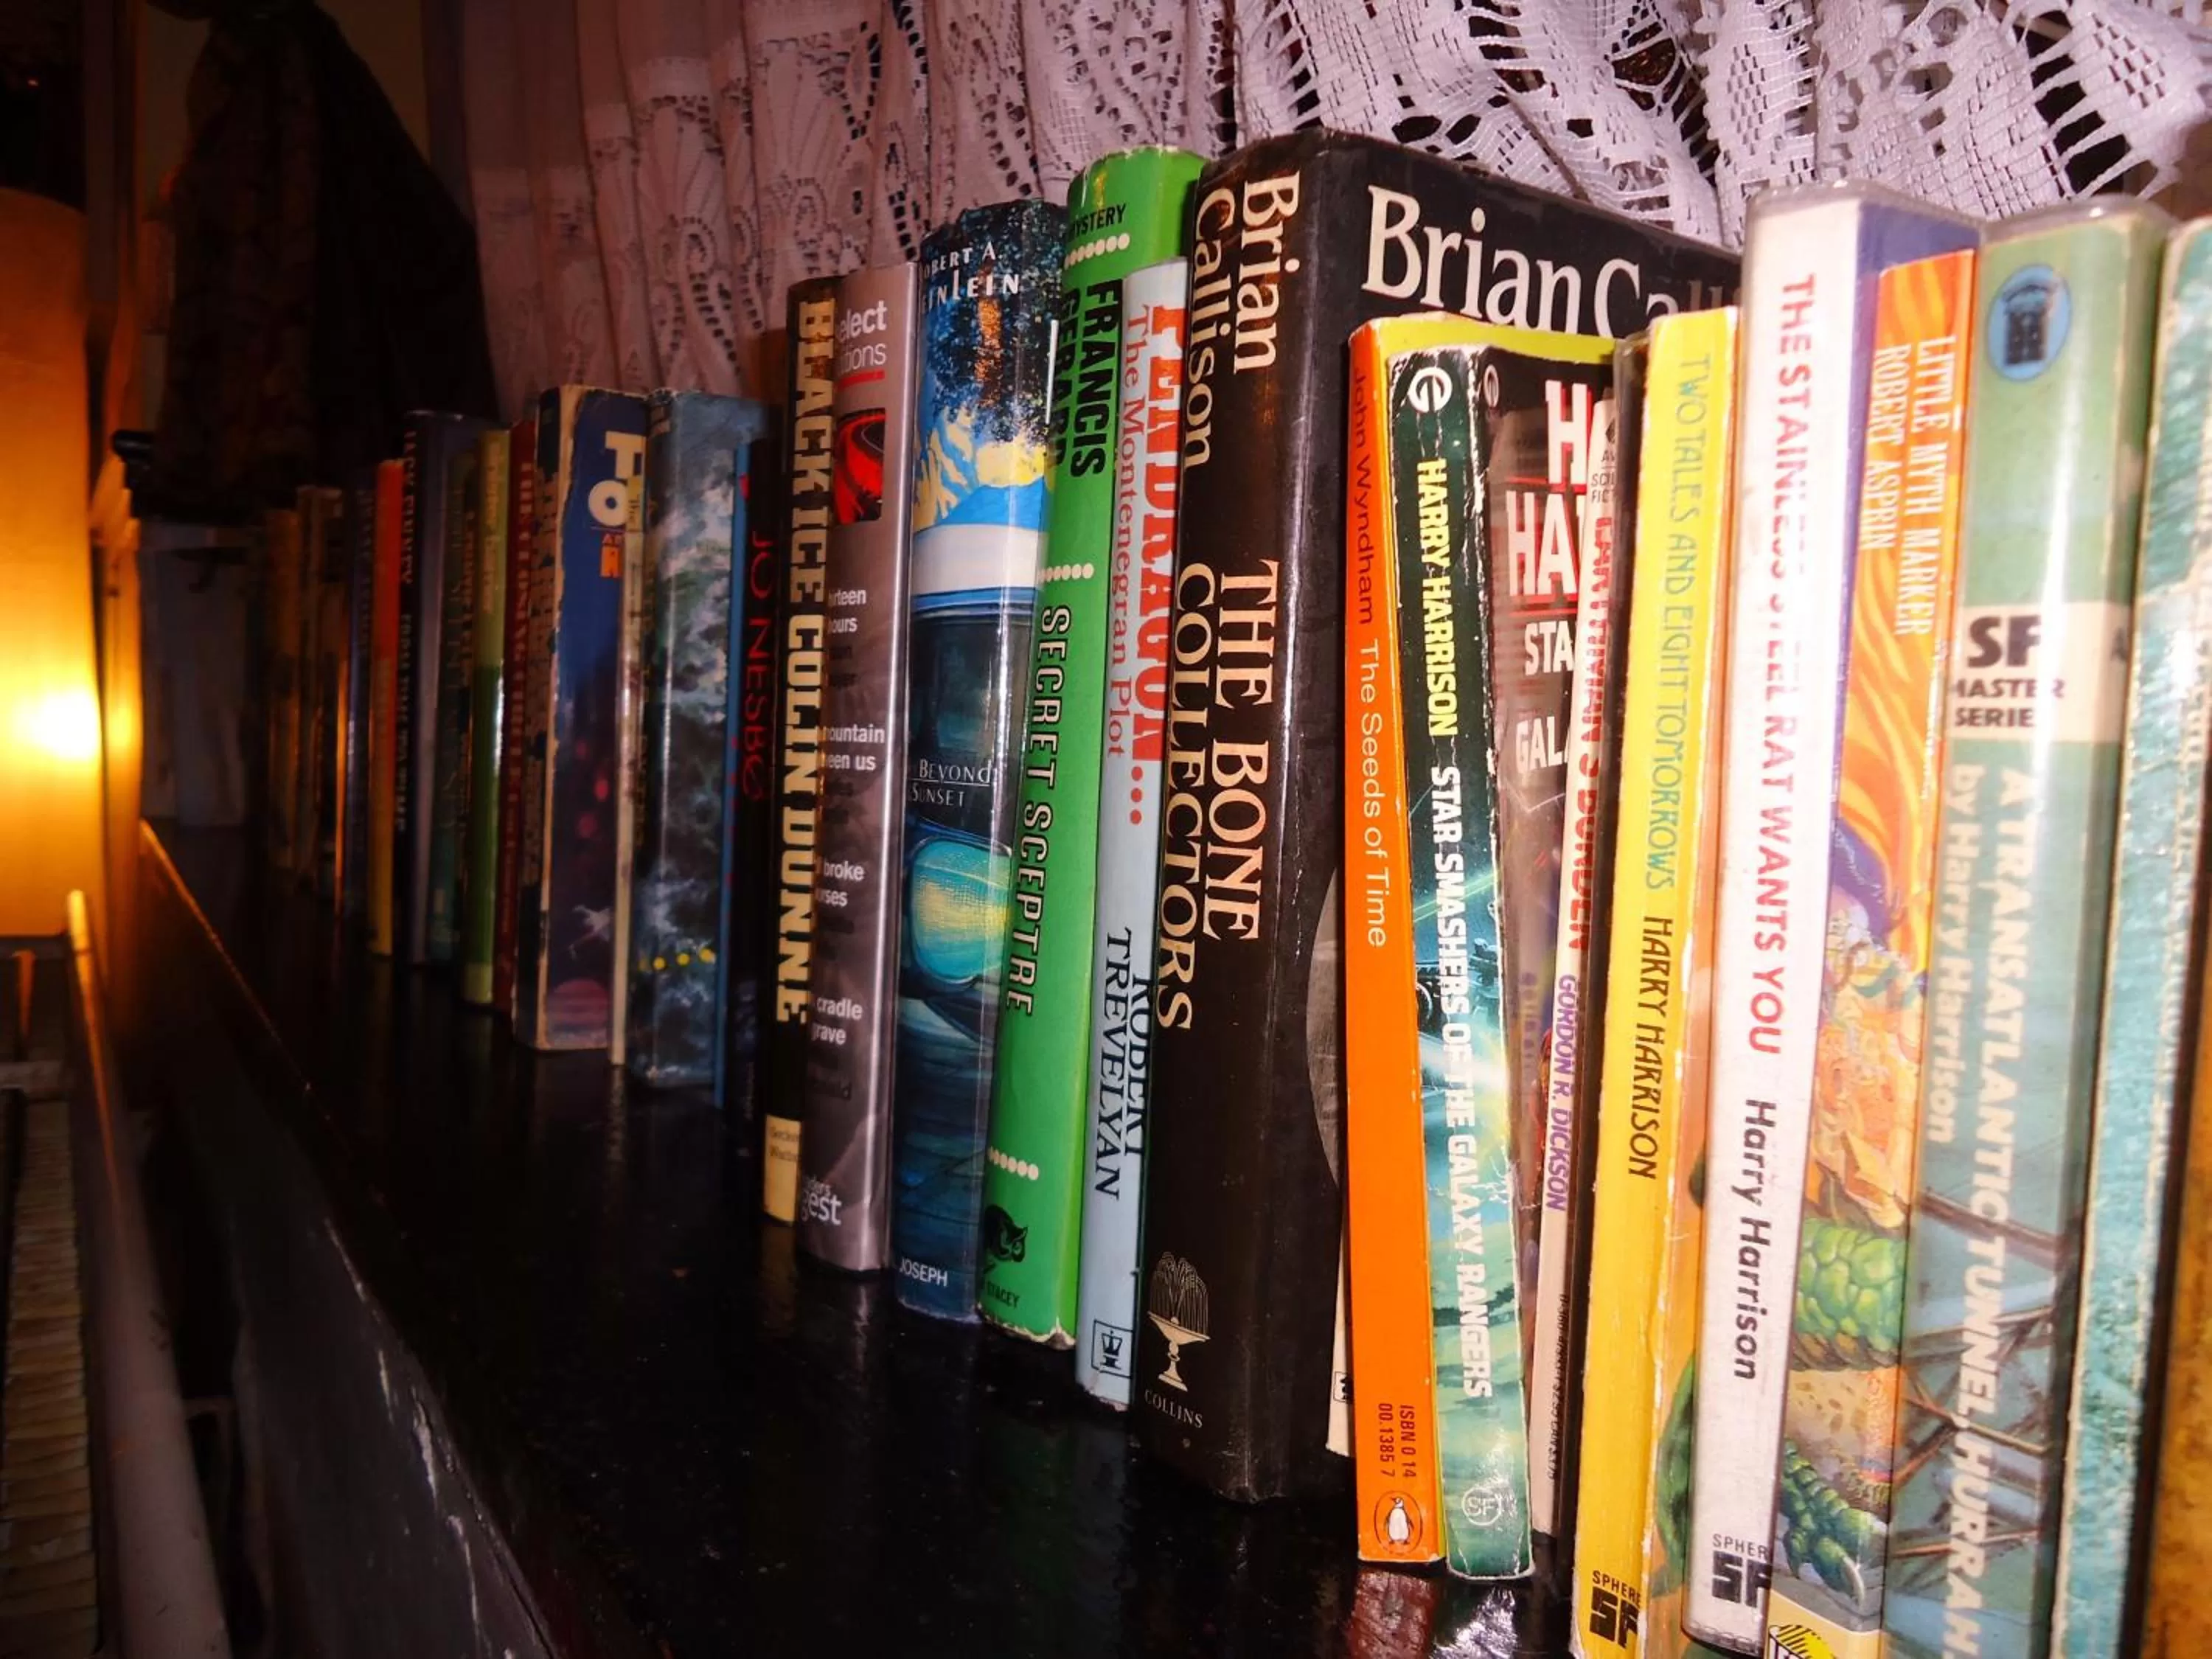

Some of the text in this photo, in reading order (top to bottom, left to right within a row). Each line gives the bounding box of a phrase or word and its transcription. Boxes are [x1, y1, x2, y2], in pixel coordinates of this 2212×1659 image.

[1183, 188, 1236, 470] Callison
[1233, 170, 1301, 374] Brian
[1361, 184, 1583, 335] Brian
[1778, 273, 1815, 354] THE
[1071, 278, 1124, 478] FRANCIS
[1860, 344, 1912, 553] ROBERT ASPRIN
[1107, 311, 1149, 757] The Montenegran Plot
[1895, 335, 1956, 636] LITTLE MYTH MARKER
[749, 532, 775, 598] JO
[776, 297, 837, 1024] BLACK ICE COLIN DUNNE
[1352, 371, 1391, 947] John Wyndham The Seeds of Time
[1967, 614, 2042, 669] SF
[855, 755, 877, 771] us
[1202, 558, 1279, 941] THE BONE
[1515, 716, 1569, 775] GAL
[1628, 354, 1711, 1180] TWO TALES AND EIGHT TOMORROWS HARRY HARRISON
[1759, 715, 1799, 793] RAT
[1955, 707, 2035, 728] SERIE
[1998, 768, 2034, 807] A
[1006, 606, 1071, 1015] SECRET SCEPTRE
[1156, 563, 1216, 1030] COLLECTORS
[824, 860, 865, 882] broke
[1416, 457, 1492, 1398] HARRY HARRISON STAR SMASHERS OF THE GALAXY RANGERS
[1753, 806, 1793, 951] WANTS
[816, 997, 863, 1021] cradle
[1747, 966, 1785, 1054] YOU
[1927, 764, 1986, 1144] by Harry Harrison
[1970, 813, 2039, 1222] TRANSATLANTIC
[1095, 927, 1133, 1201] TREVELYAN
[1545, 973, 1577, 1212] GORDON R. DICKSON
[899, 1256, 948, 1288] JOSEPH
[1731, 1099, 1778, 1381] Harry Harrison
[1143, 1388, 1203, 1429] COLLINS
[1381, 1468, 1396, 1478] 7
[1400, 1404, 1416, 1478] ISBN 0 14
[1467, 1496, 1492, 1517] SF
[1711, 1550, 1772, 1608] SF
[1589, 1587, 1640, 1649] SF
[1591, 1569, 1642, 1606] SPHERE
